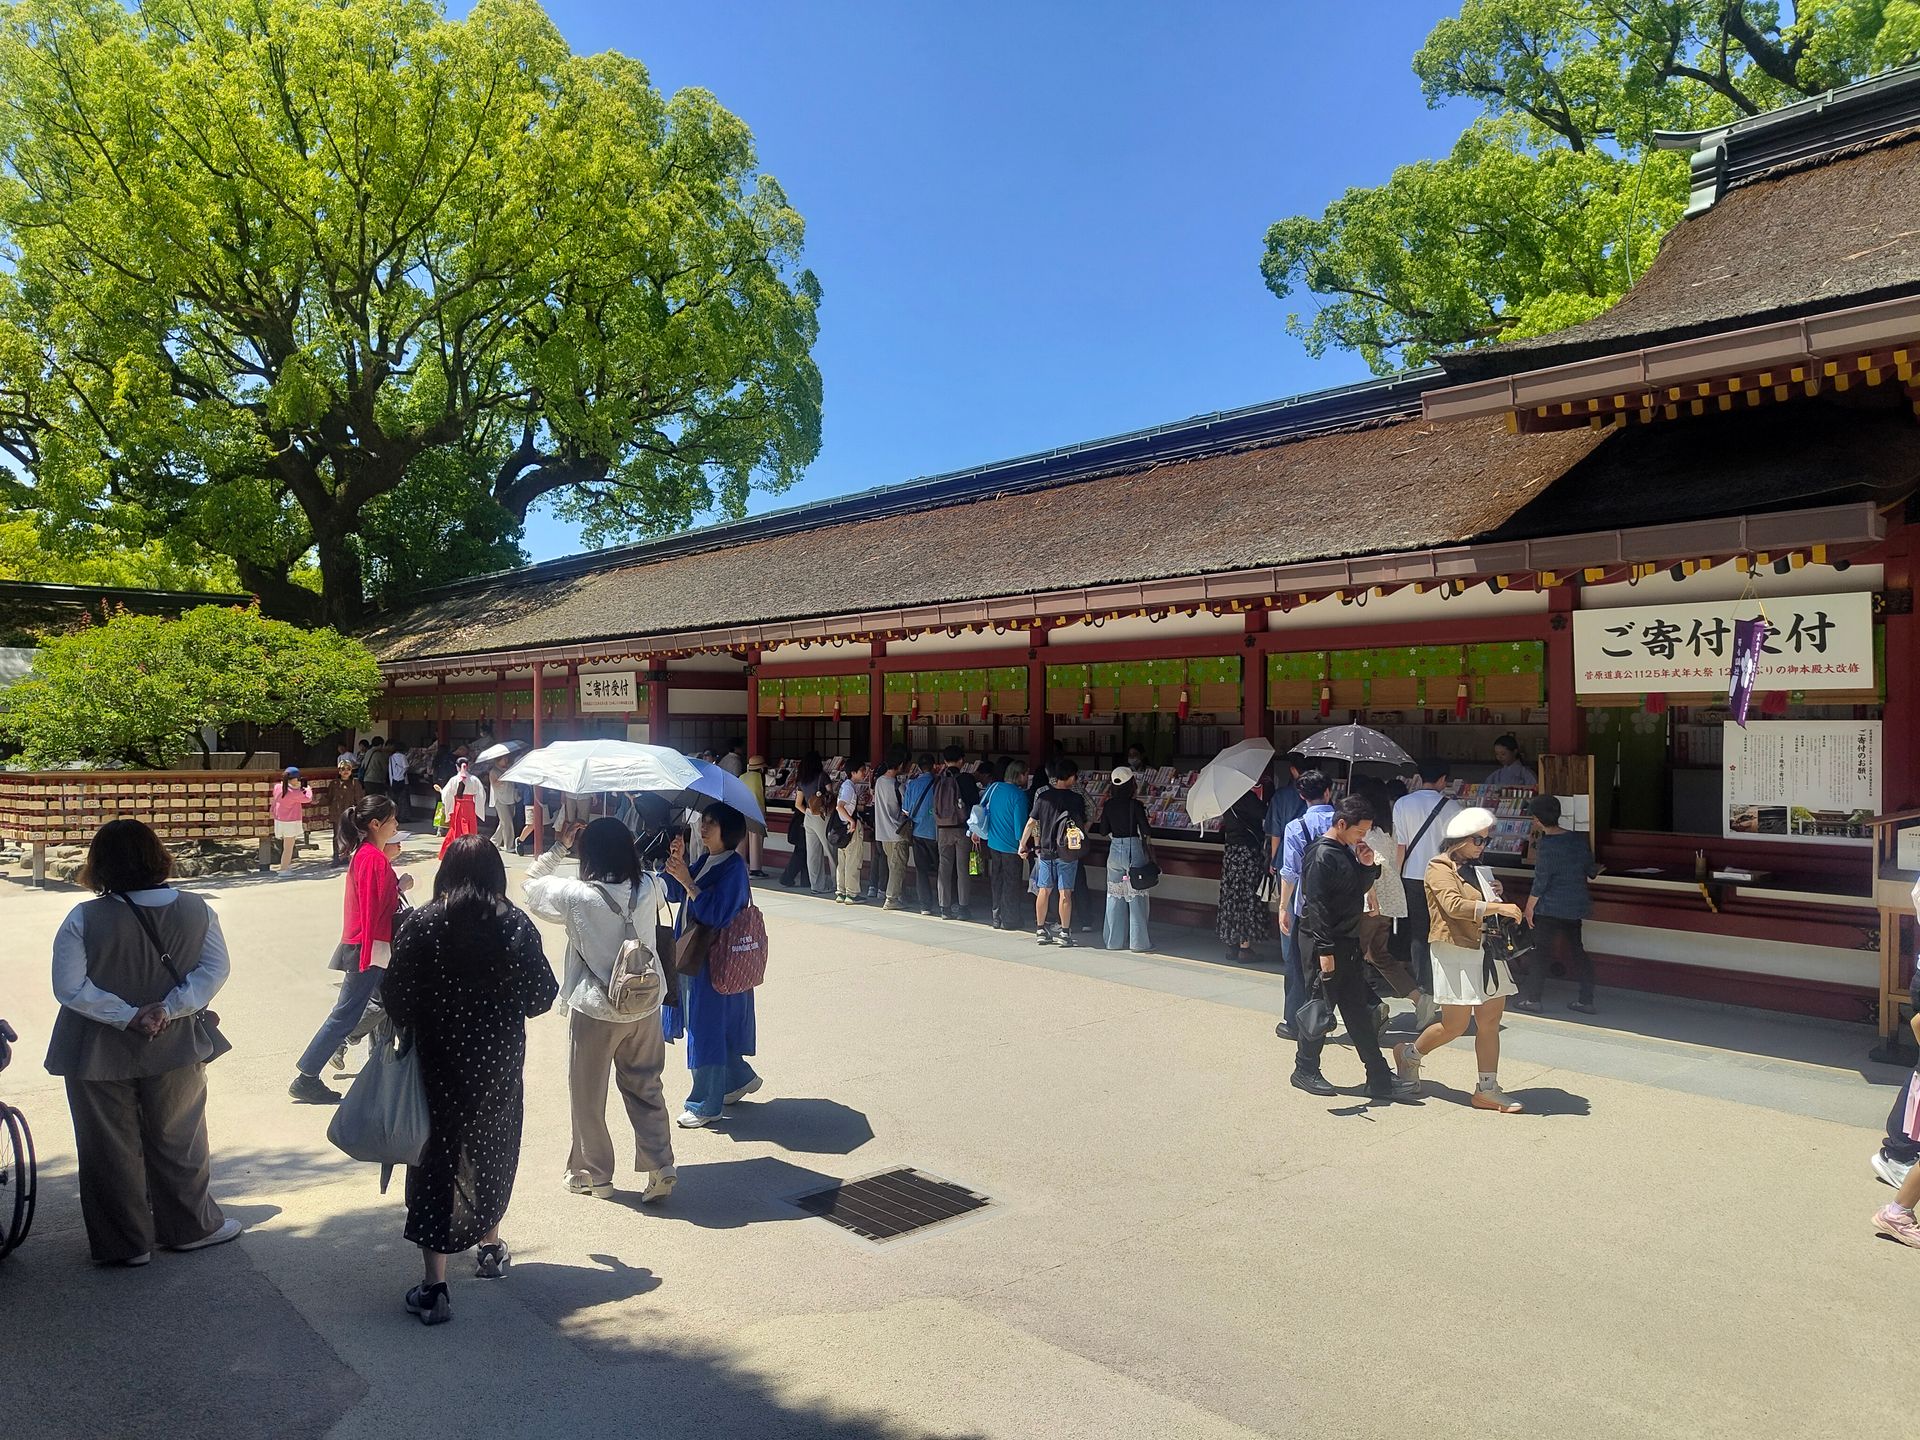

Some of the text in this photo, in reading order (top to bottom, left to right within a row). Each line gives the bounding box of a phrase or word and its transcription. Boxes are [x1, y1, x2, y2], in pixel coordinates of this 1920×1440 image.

[1584, 663, 1861, 680] 菅原道真公1125年式年大祭 12ぶりの御本殿大改修
[585, 678, 629, 698] ご寄付受付
[1857, 728, 1867, 781] ご寄付のお願い
